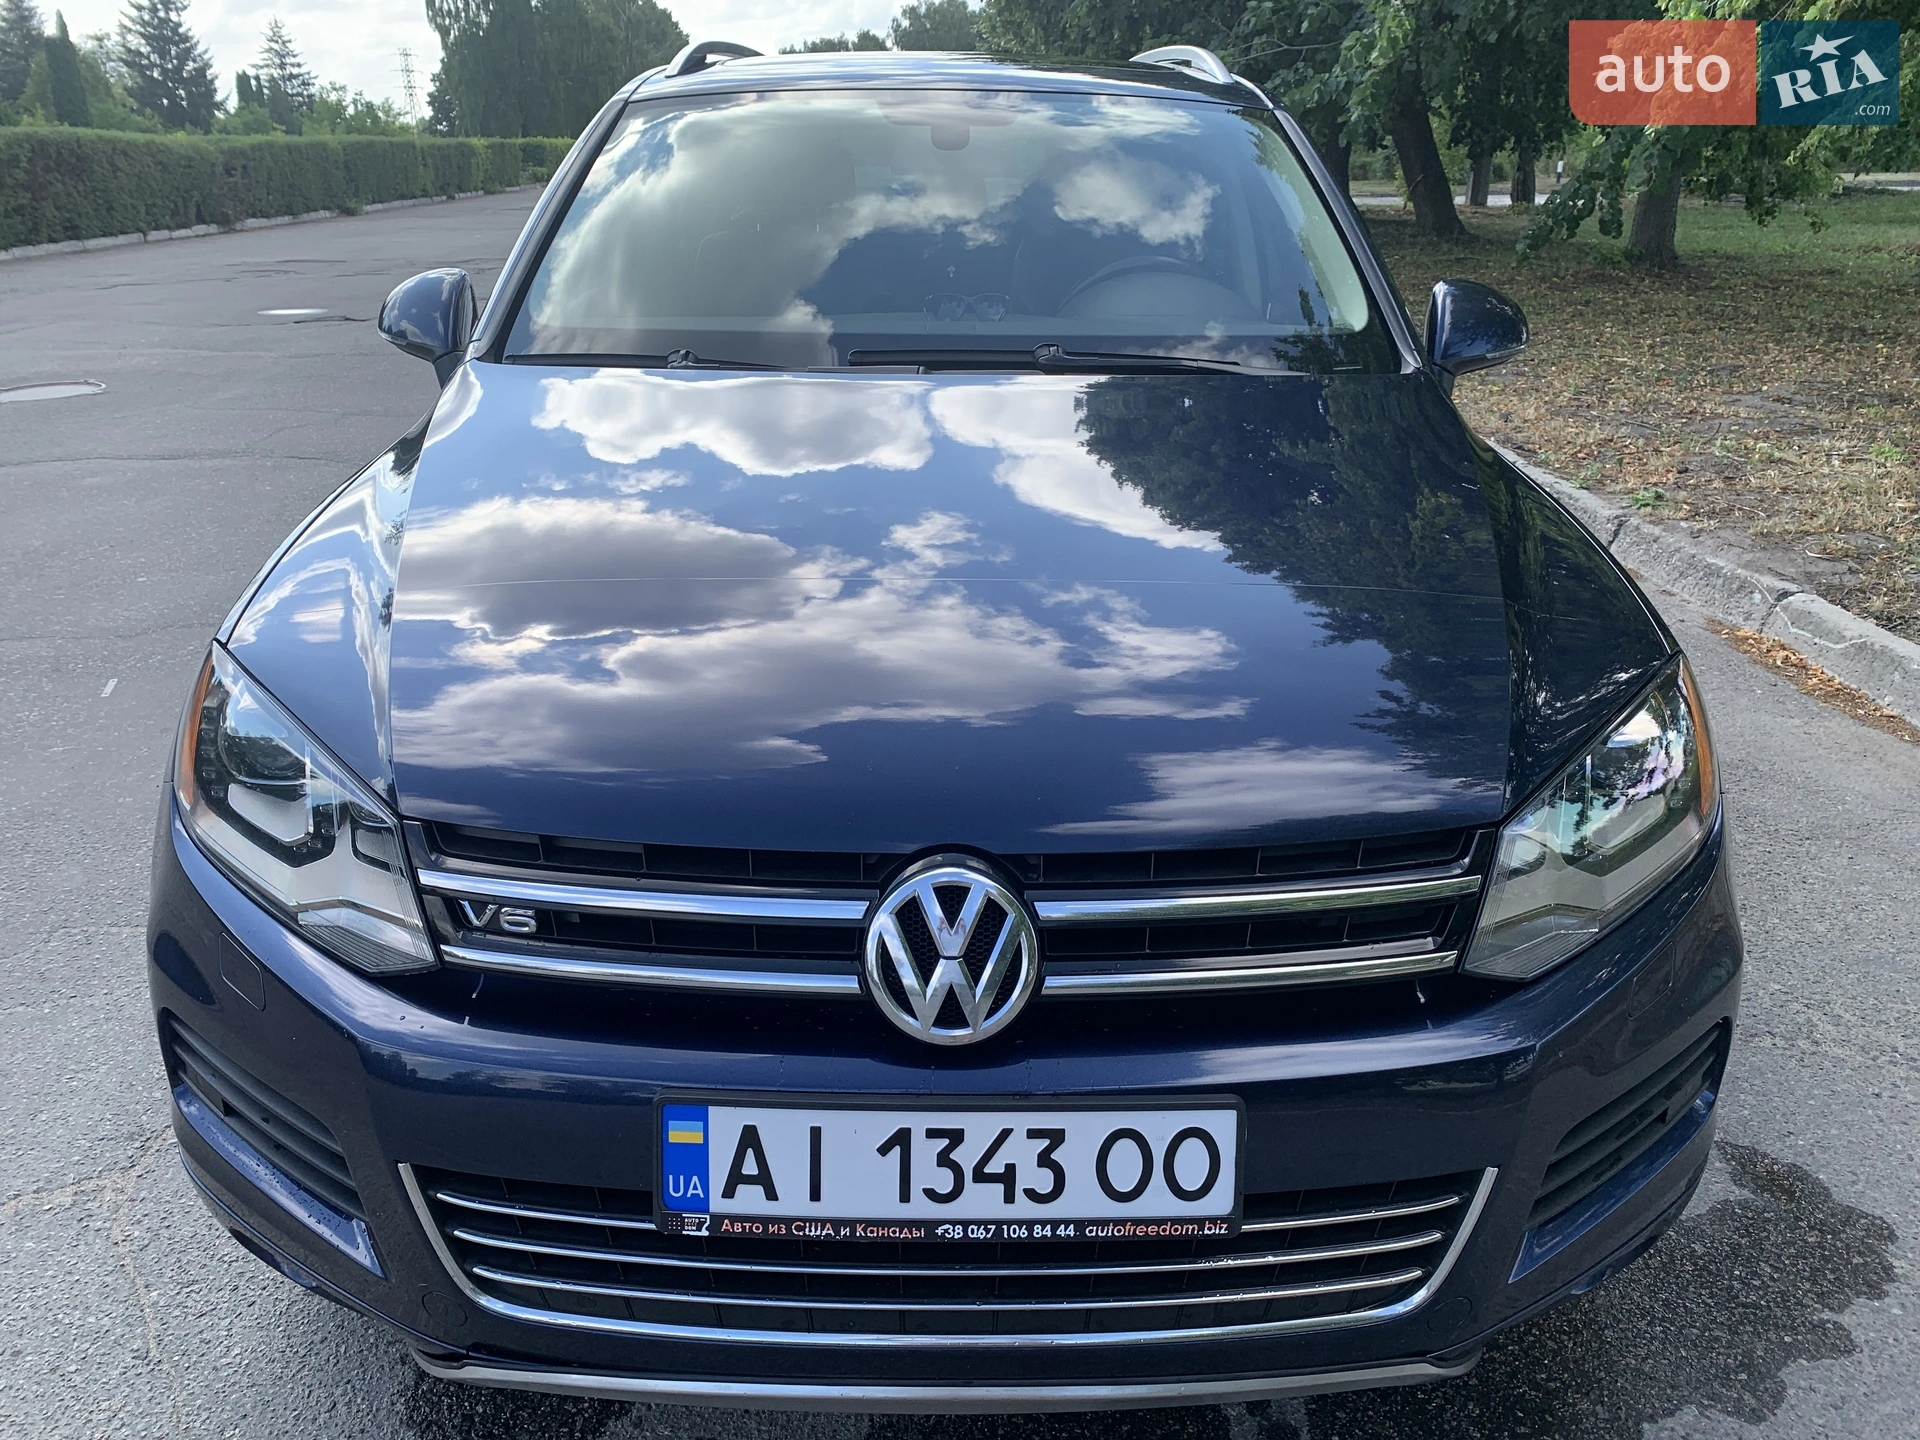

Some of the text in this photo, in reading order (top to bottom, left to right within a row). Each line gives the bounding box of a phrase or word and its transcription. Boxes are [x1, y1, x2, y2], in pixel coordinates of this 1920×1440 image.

[458, 900, 537, 933] V6
[721, 1125, 1221, 1204] AI 1343 OO
[669, 1175, 704, 1198] UA
[721, 1219, 763, 1234] Авто
[768, 1223, 787, 1235] из
[791, 1221, 835, 1237] США
[840, 1226, 850, 1238] и
[856, 1223, 925, 1239] Канады
[968, 1225, 996, 1239] 067
[1002, 1225, 1028, 1238] 106
[1033, 1224, 1051, 1238] 84
[1056, 1224, 1075, 1237] 44
[1085, 1220, 1229, 1237] autofreedom.biz
